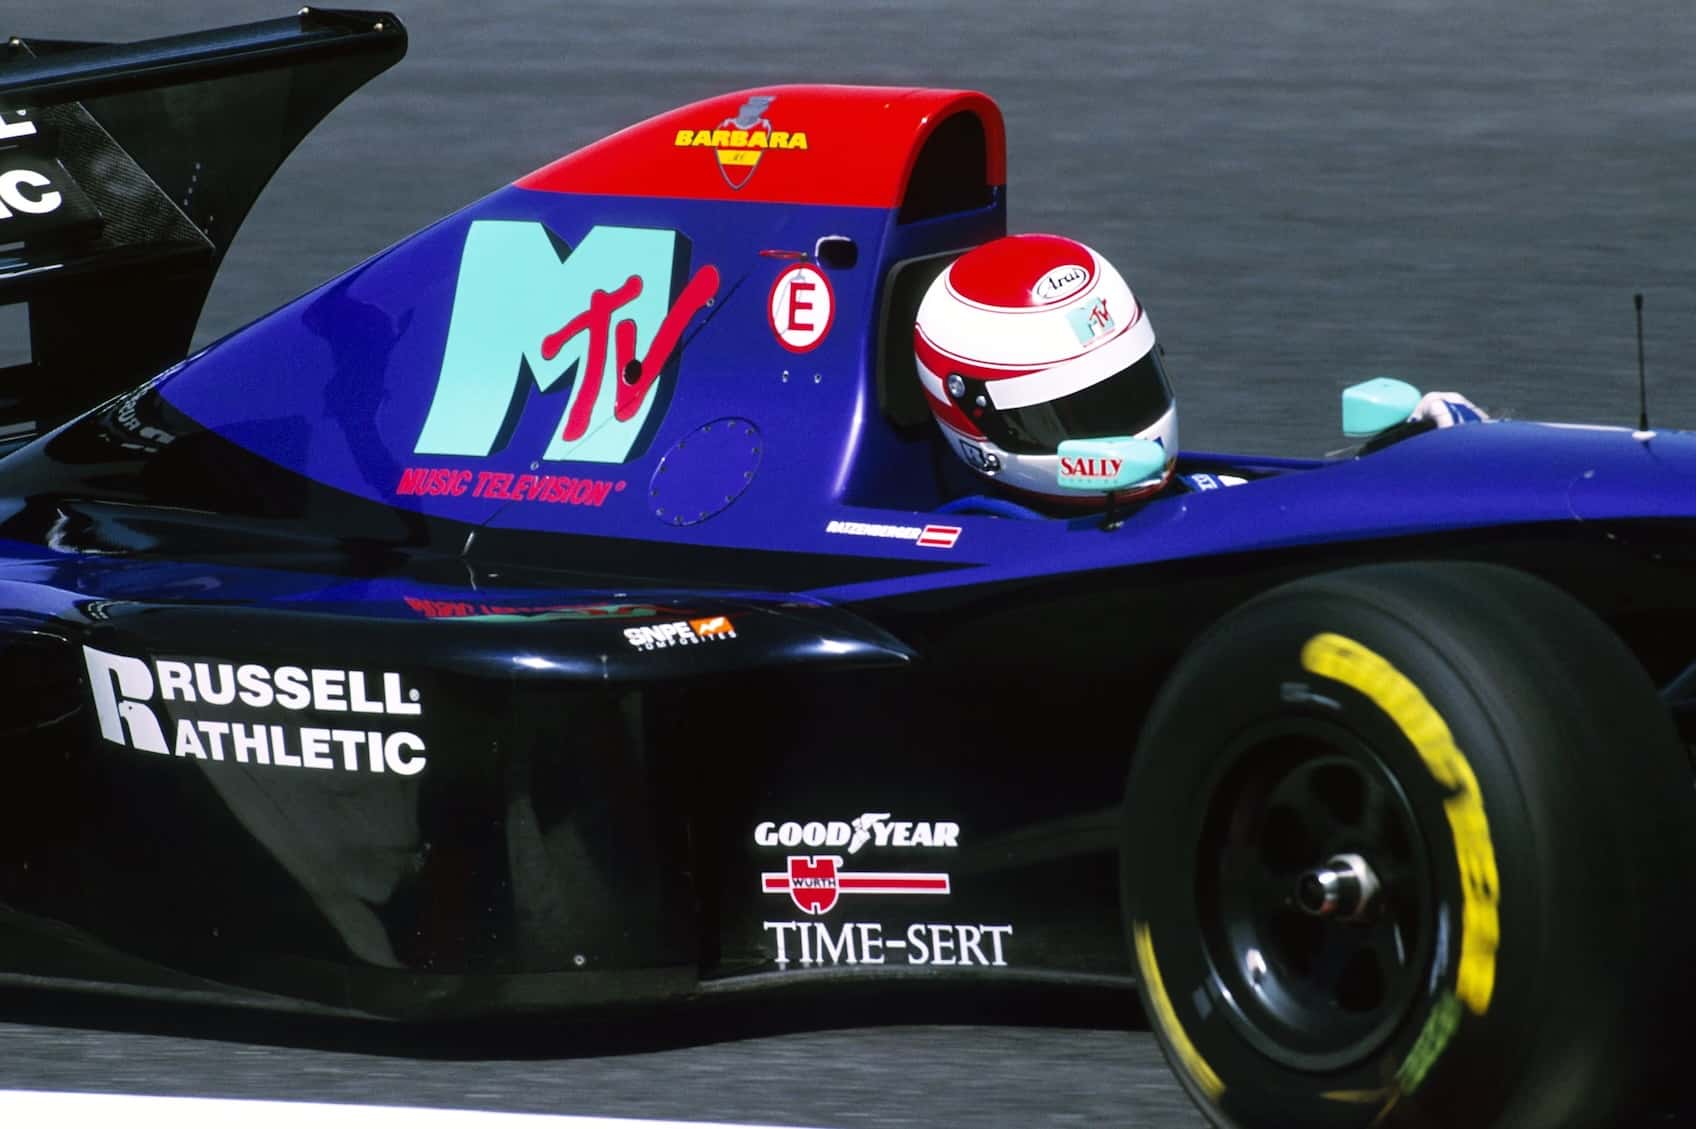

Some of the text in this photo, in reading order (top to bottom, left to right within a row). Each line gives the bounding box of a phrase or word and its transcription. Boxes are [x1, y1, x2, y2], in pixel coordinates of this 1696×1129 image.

[675, 130, 808, 150] BARBARA
[1042, 269, 1081, 298] Arai
[788, 282, 815, 331] E
[1065, 297, 1115, 344] MTV
[413, 219, 720, 465] MTV
[396, 468, 613, 507] MUSIC TELEVISION
[1061, 457, 1123, 478] SALLY
[624, 621, 692, 646] SNPE
[155, 659, 421, 715] RUSSELL
[175, 719, 427, 776] ATHLETIC
[763, 921, 1013, 966] TIME-SERT
